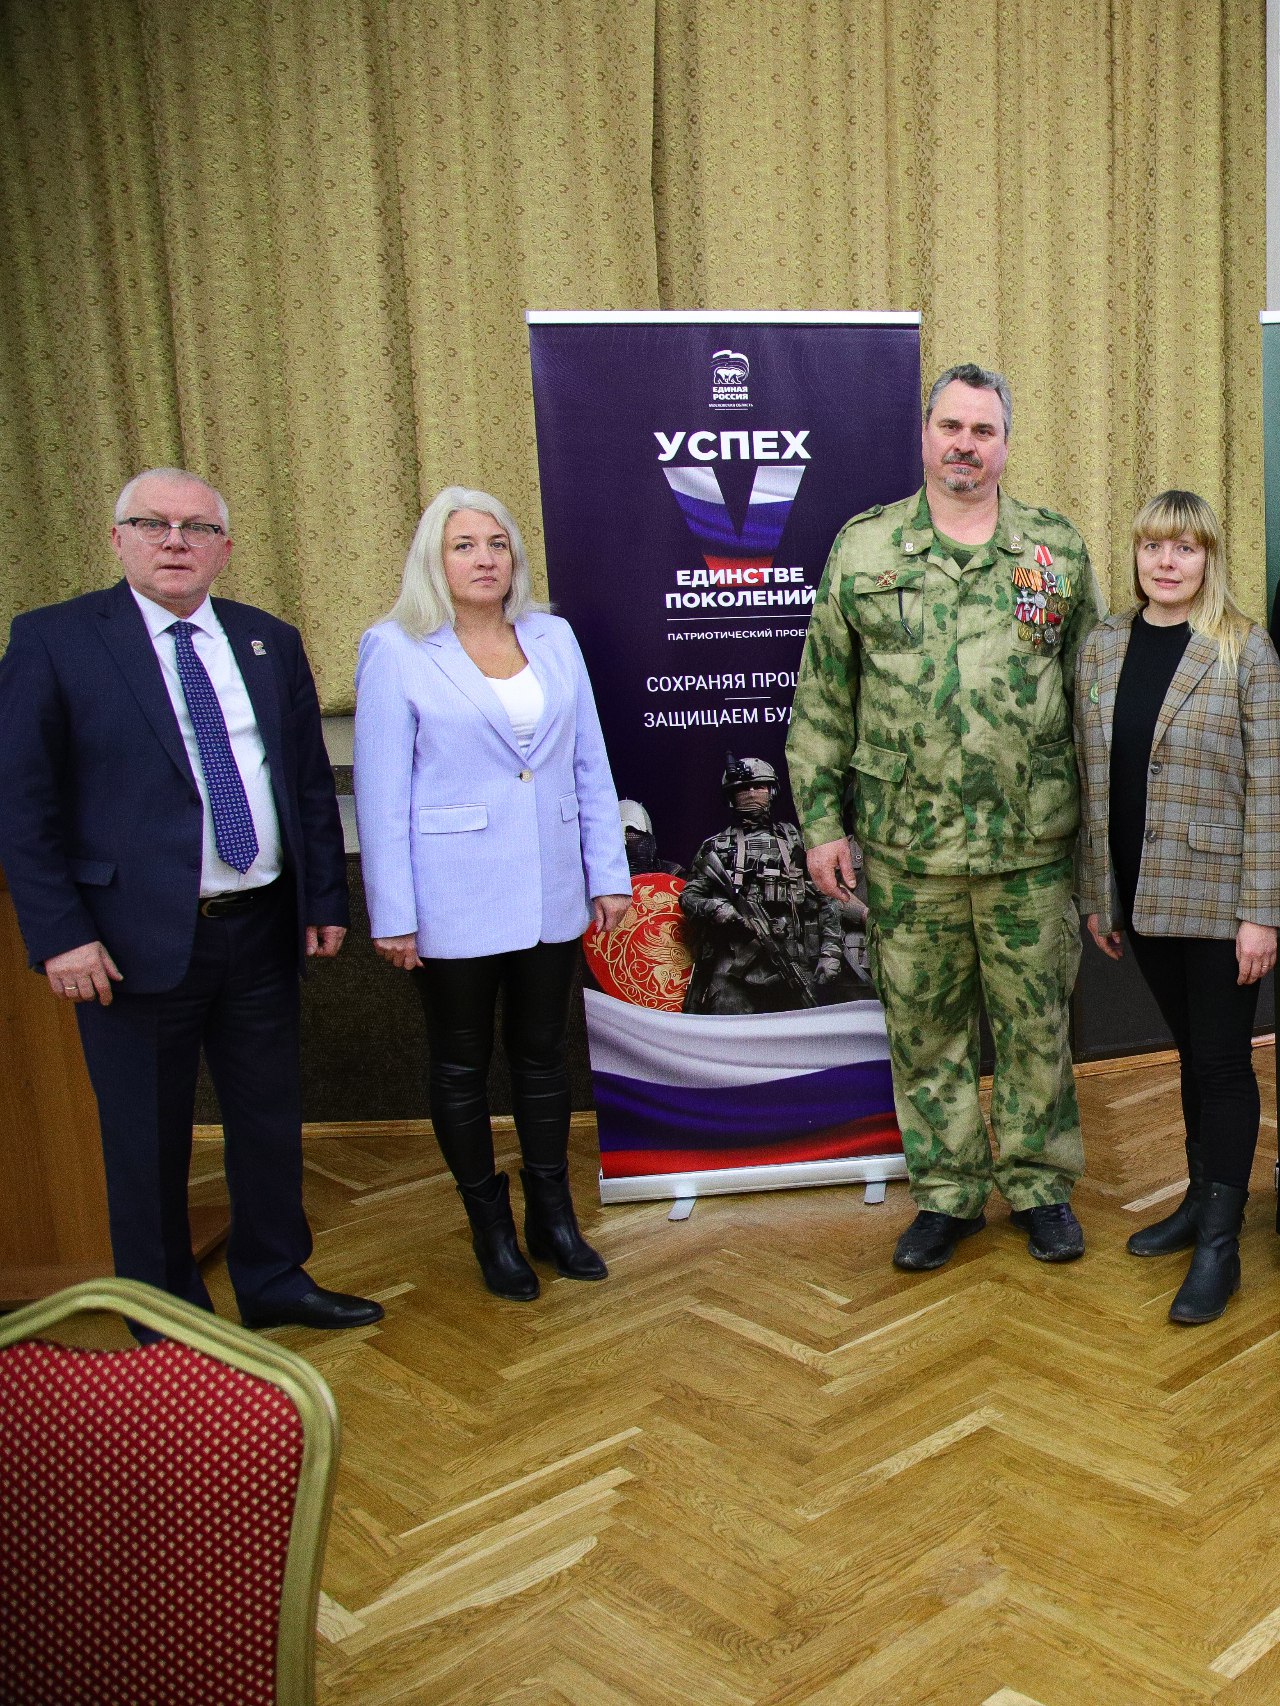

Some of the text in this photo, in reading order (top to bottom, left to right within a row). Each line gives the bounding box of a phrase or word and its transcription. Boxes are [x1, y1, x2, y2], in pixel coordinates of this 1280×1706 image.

[653, 430, 812, 461] УСПЕХ
[676, 567, 805, 588] ЕДИНСТВЕ
[665, 585, 817, 609] ПОКОЛЕНИЙ
[667, 628, 809, 641] ПАТРИОТИЧЕСКИЙ ПРОЕ
[646, 673, 746, 692] СОХРАНЯЯ
[643, 708, 759, 730] ЗАЩИЩАЕМ
